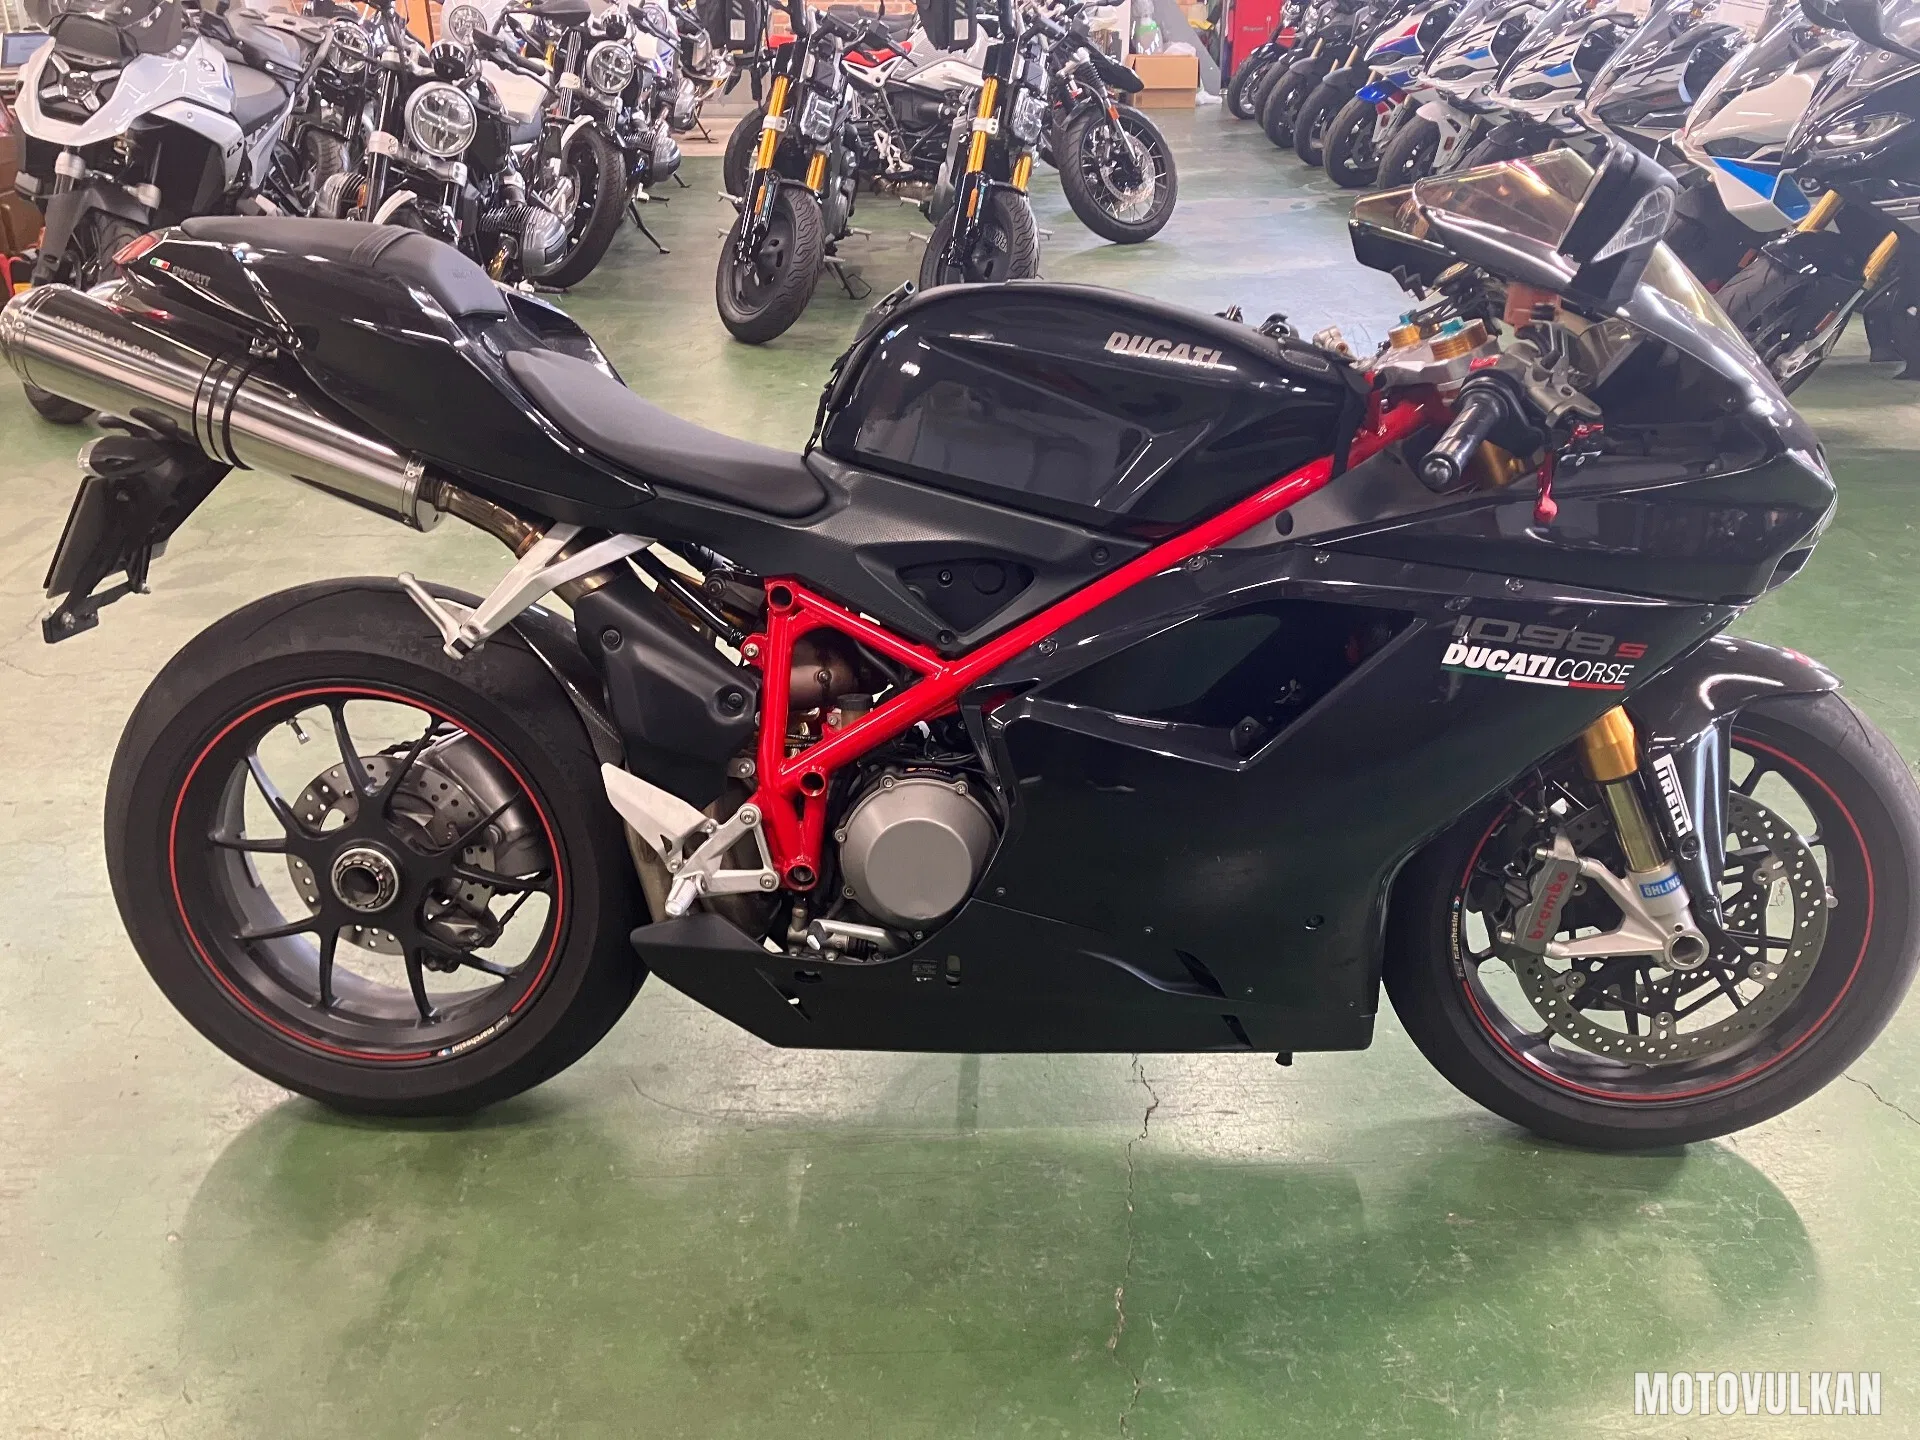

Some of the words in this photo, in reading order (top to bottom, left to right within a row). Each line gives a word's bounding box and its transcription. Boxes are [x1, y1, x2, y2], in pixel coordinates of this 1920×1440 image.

[171, 265, 212, 287] DUCATI
[1103, 331, 1223, 369] DUCATI
[1441, 642, 1557, 678] DUCATI
[1555, 658, 1635, 684] CORSE
[1652, 753, 1693, 838] PIRELLI
[1527, 871, 1569, 940] brembo
